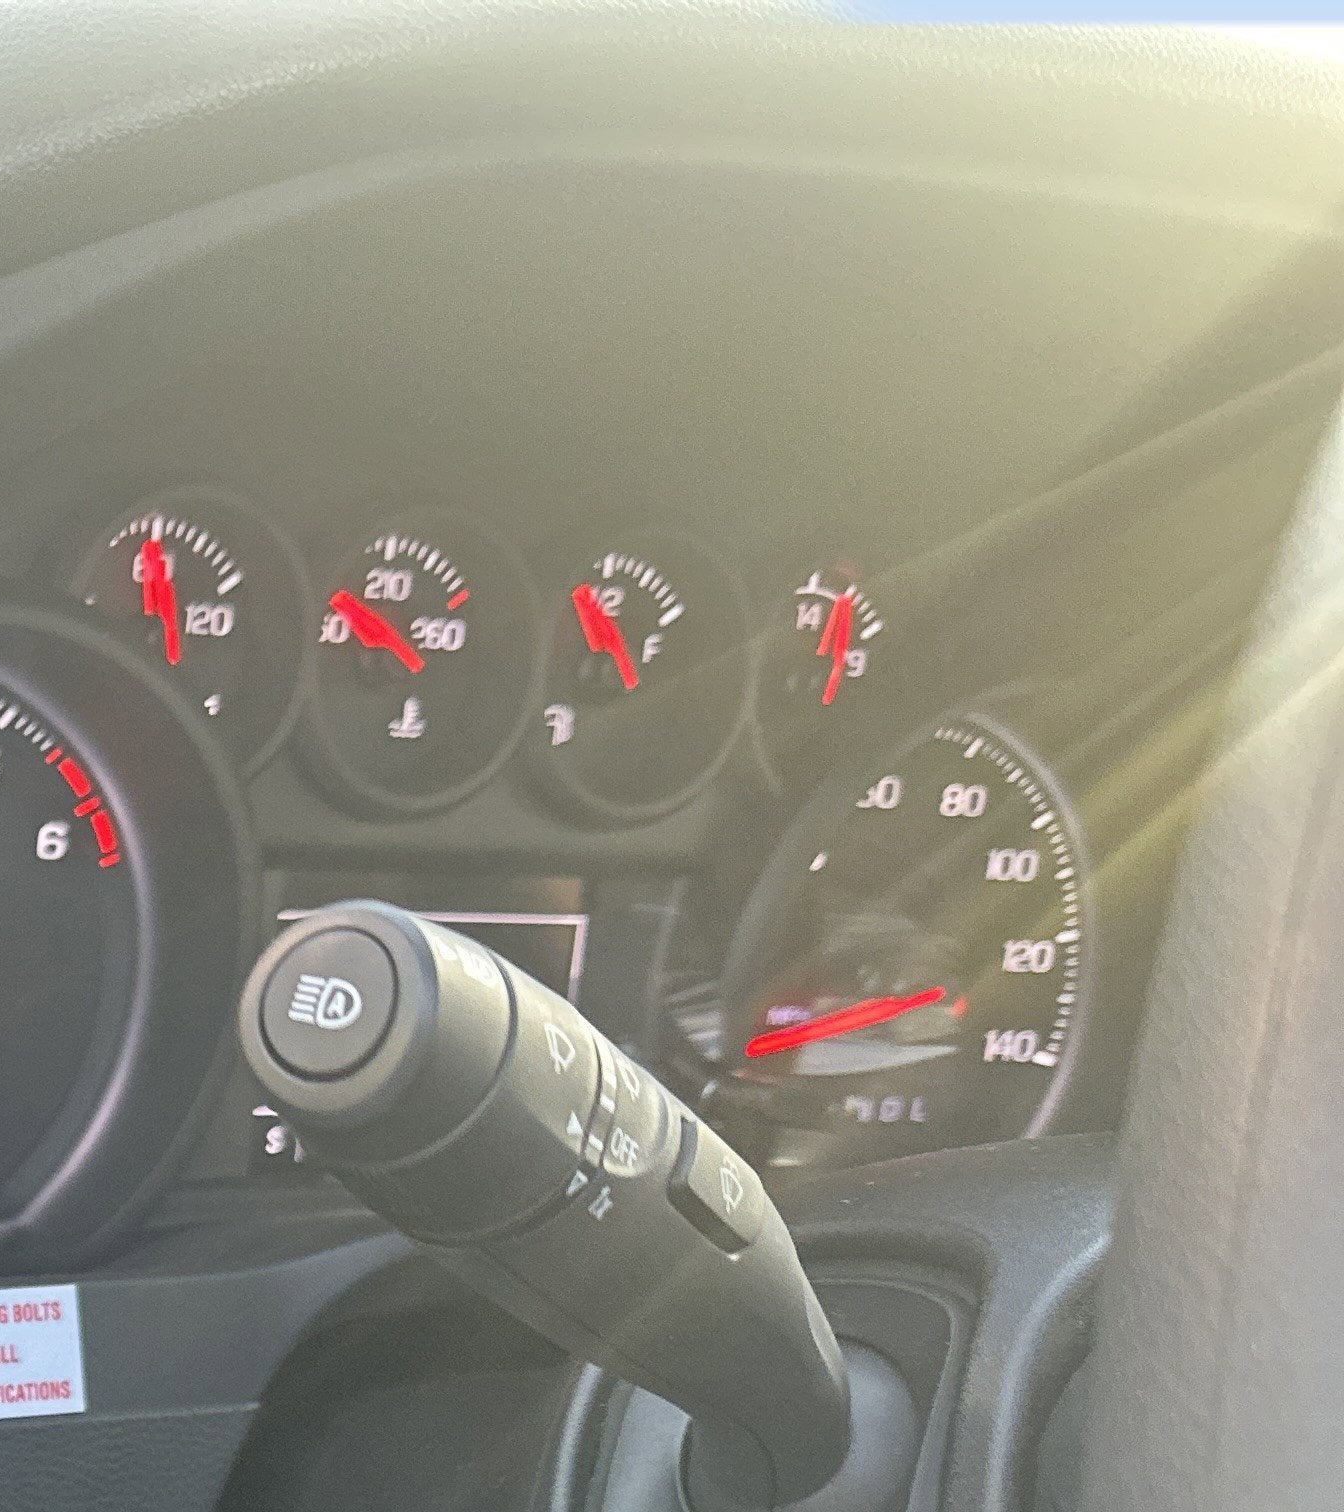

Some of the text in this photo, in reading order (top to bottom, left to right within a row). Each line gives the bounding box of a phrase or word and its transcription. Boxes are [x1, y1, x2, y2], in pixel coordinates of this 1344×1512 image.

[185, 603, 234, 637] 120
[940, 782, 987, 818] 80
[36, 821, 69, 861] 6
[986, 848, 1041, 882] 100
[1002, 939, 1056, 973] 120
[984, 1029, 1039, 1063] 140
[611, 1127, 639, 1168] OFF
[13, 1300, 62, 1324] BOLTS
